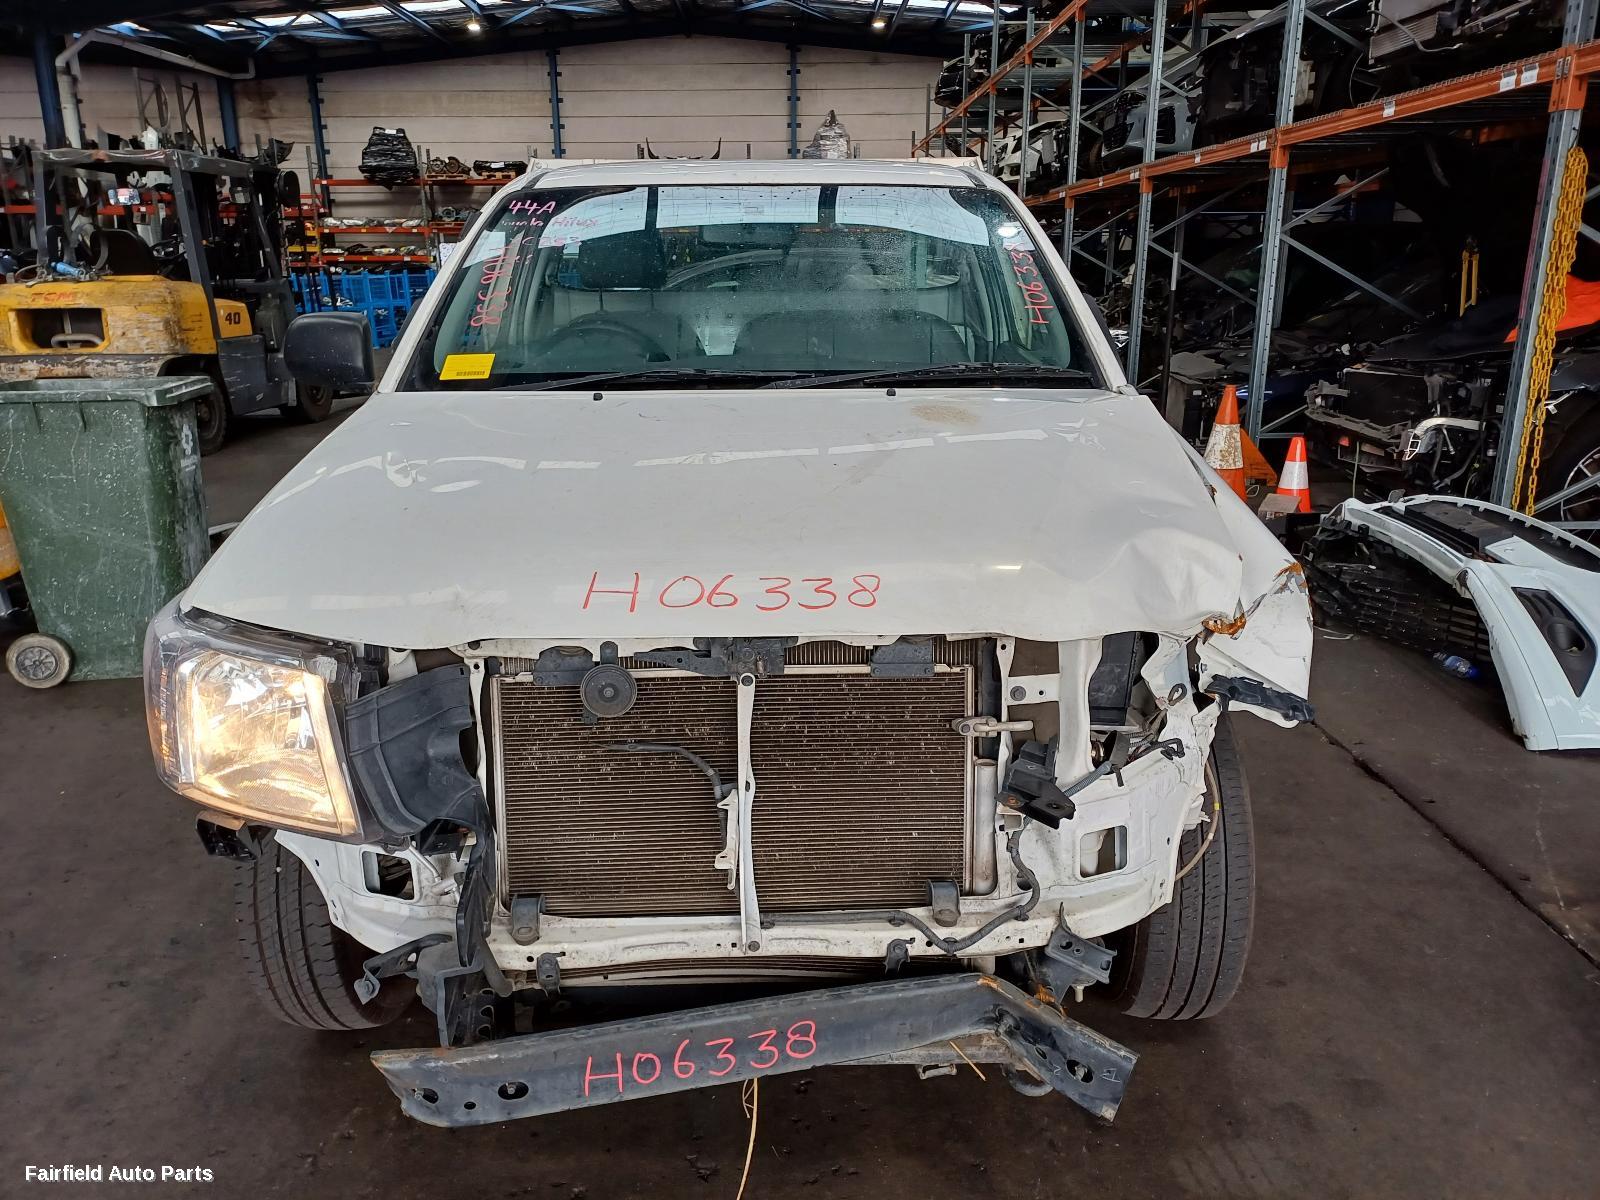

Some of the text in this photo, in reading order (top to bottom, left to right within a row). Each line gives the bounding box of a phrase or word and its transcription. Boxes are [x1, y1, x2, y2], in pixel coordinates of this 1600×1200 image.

[509, 200, 556, 215] 44A
[224, 312, 241, 325] 40
[582, 572, 880, 612] H06338
[583, 1020, 817, 1096] H06338
